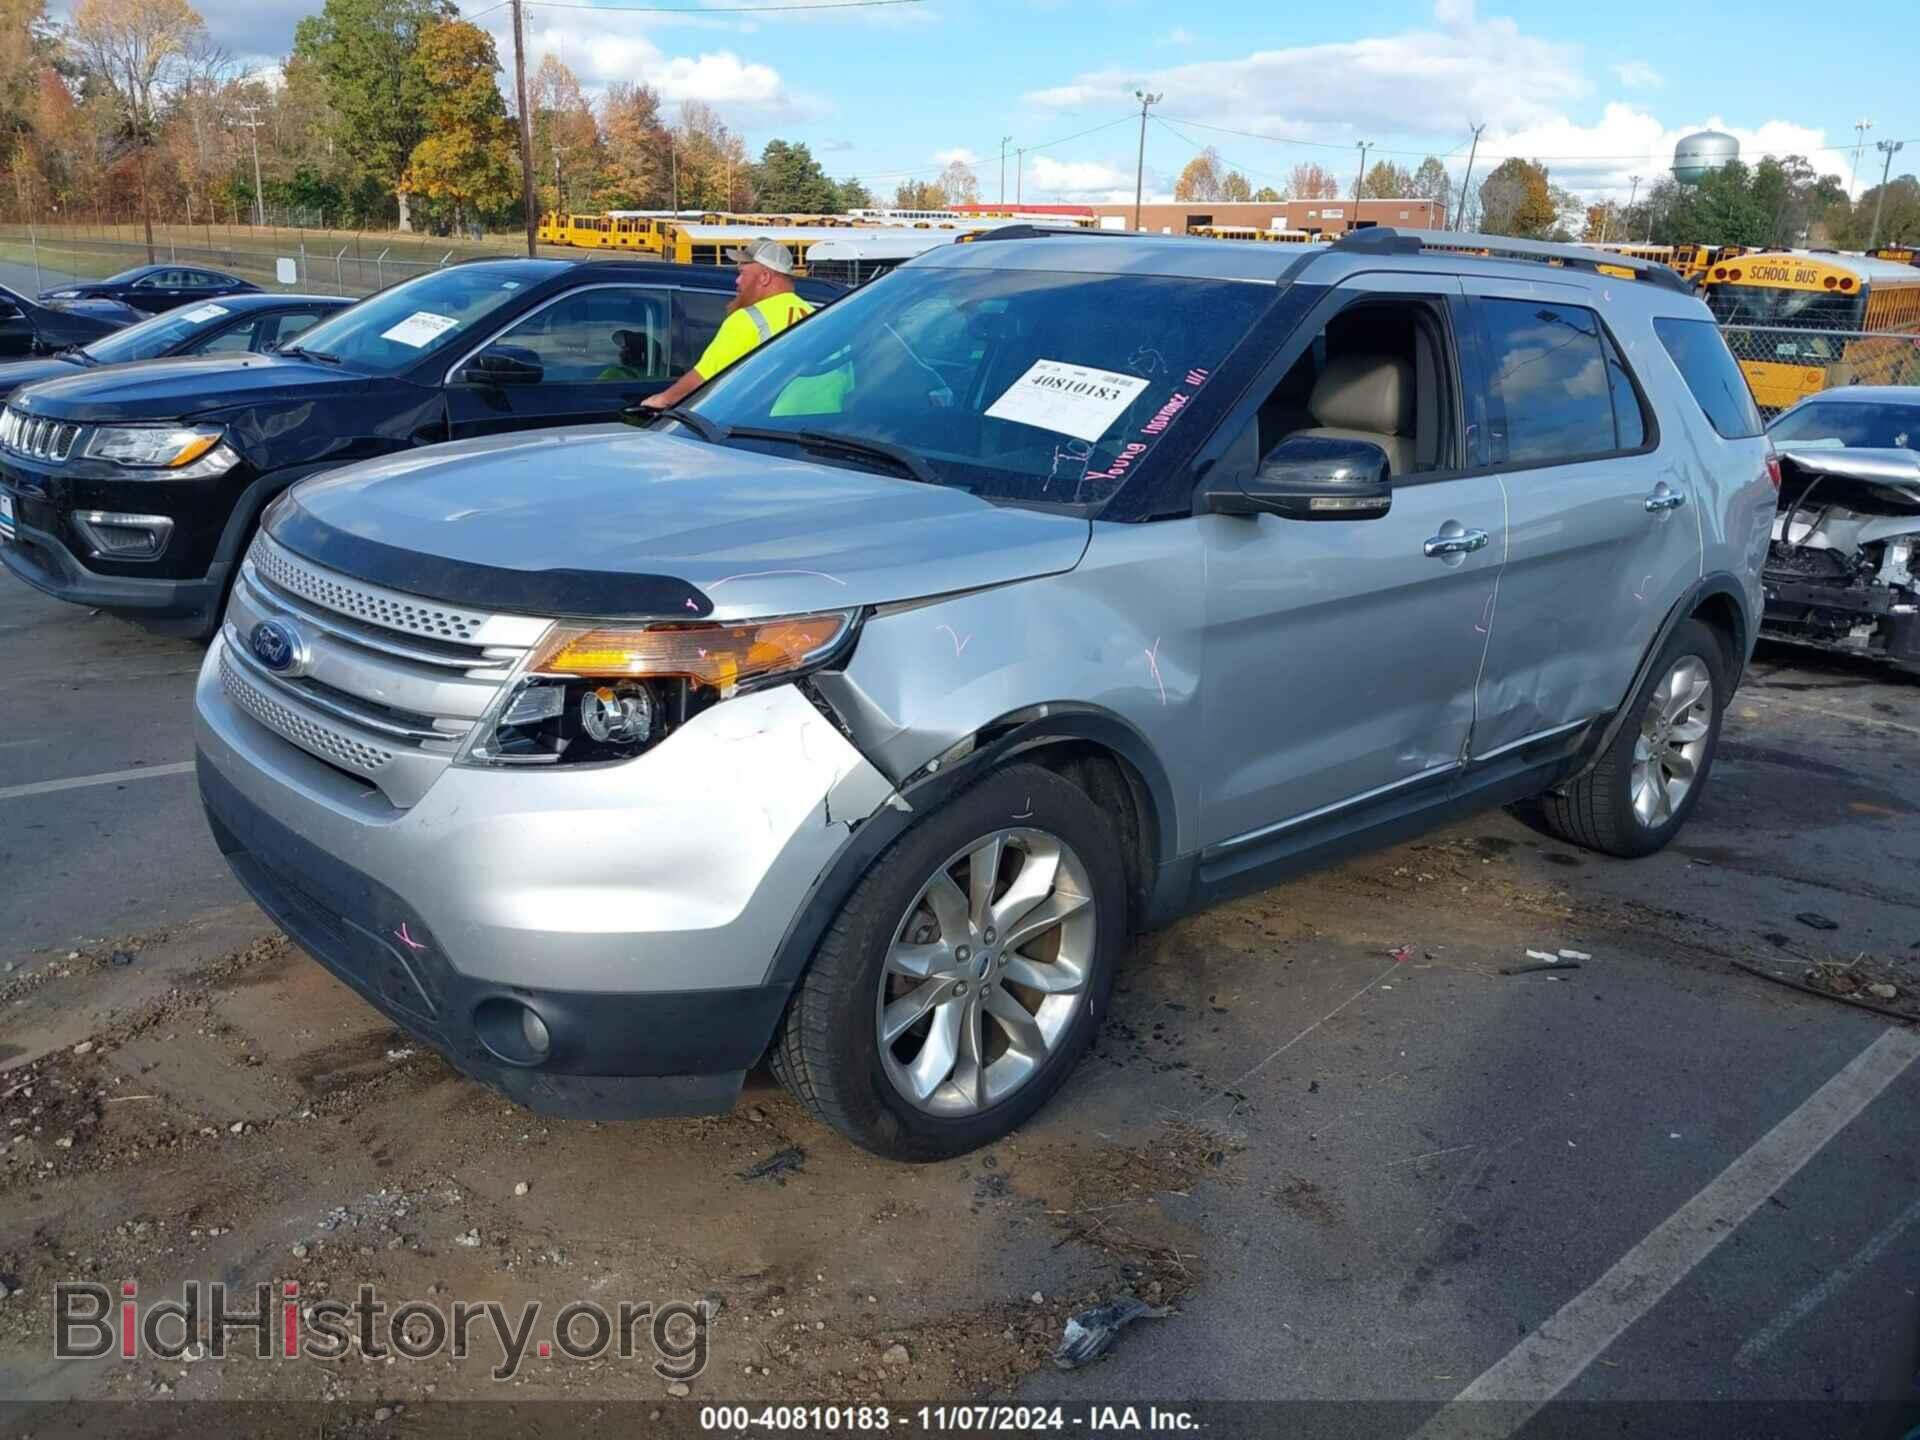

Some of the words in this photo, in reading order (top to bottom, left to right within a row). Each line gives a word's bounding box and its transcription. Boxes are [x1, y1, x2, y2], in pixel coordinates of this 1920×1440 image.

[1750, 265, 1790, 282] SCHOOL
[1794, 268, 1818, 284] BUS
[1032, 375, 1121, 401] 40810183
[1084, 442, 1147, 481] Young
[254, 626, 284, 662] Ford
